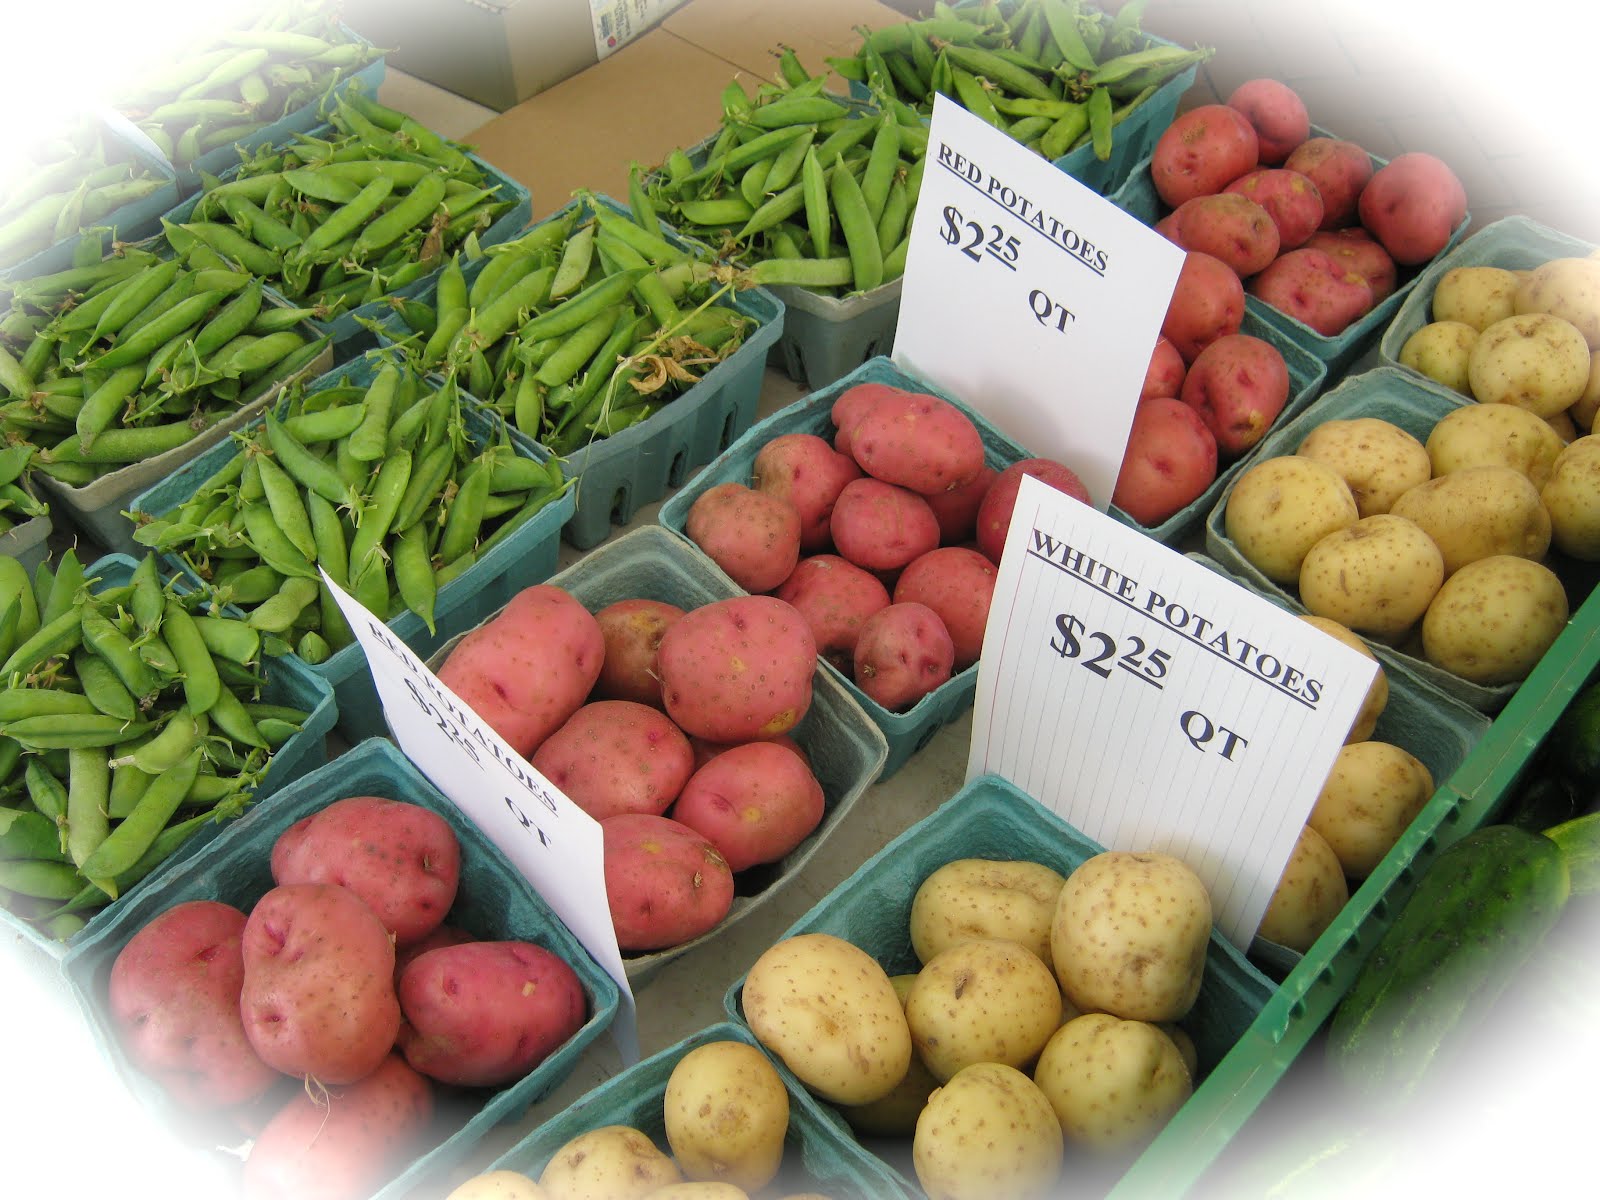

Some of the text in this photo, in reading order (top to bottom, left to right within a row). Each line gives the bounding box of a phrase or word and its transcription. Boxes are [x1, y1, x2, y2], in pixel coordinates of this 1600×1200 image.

[938, 142, 1109, 272] RED POTATOES
[1029, 289, 1076, 334] QT
[1032, 528, 1323, 703] WHITE POTATOES
[368, 621, 557, 812] RED POTATOES
[1180, 710, 1249, 762] QT
[505, 796, 552, 848] QT
